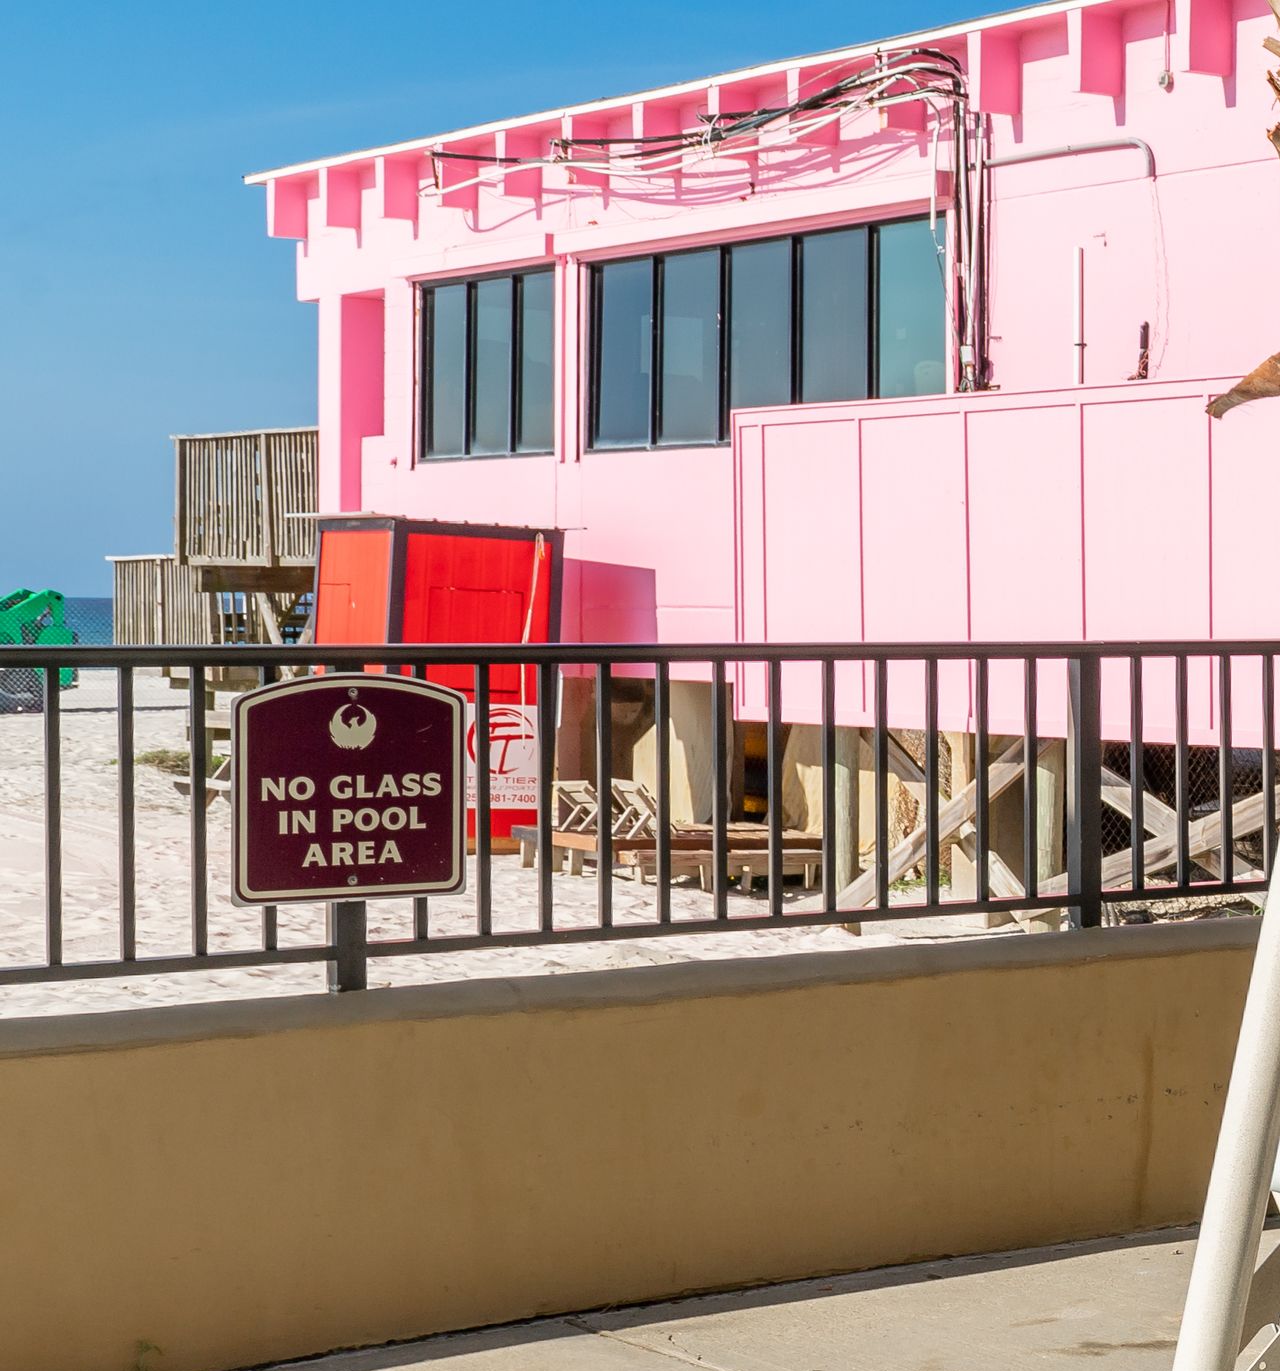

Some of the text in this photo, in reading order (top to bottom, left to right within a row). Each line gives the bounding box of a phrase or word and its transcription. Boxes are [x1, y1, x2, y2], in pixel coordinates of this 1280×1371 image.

[261, 772, 442, 802] NO GLASS
[504, 776, 537, 784] TIER
[279, 806, 427, 835] IN POOL
[301, 840, 403, 868] AREA
